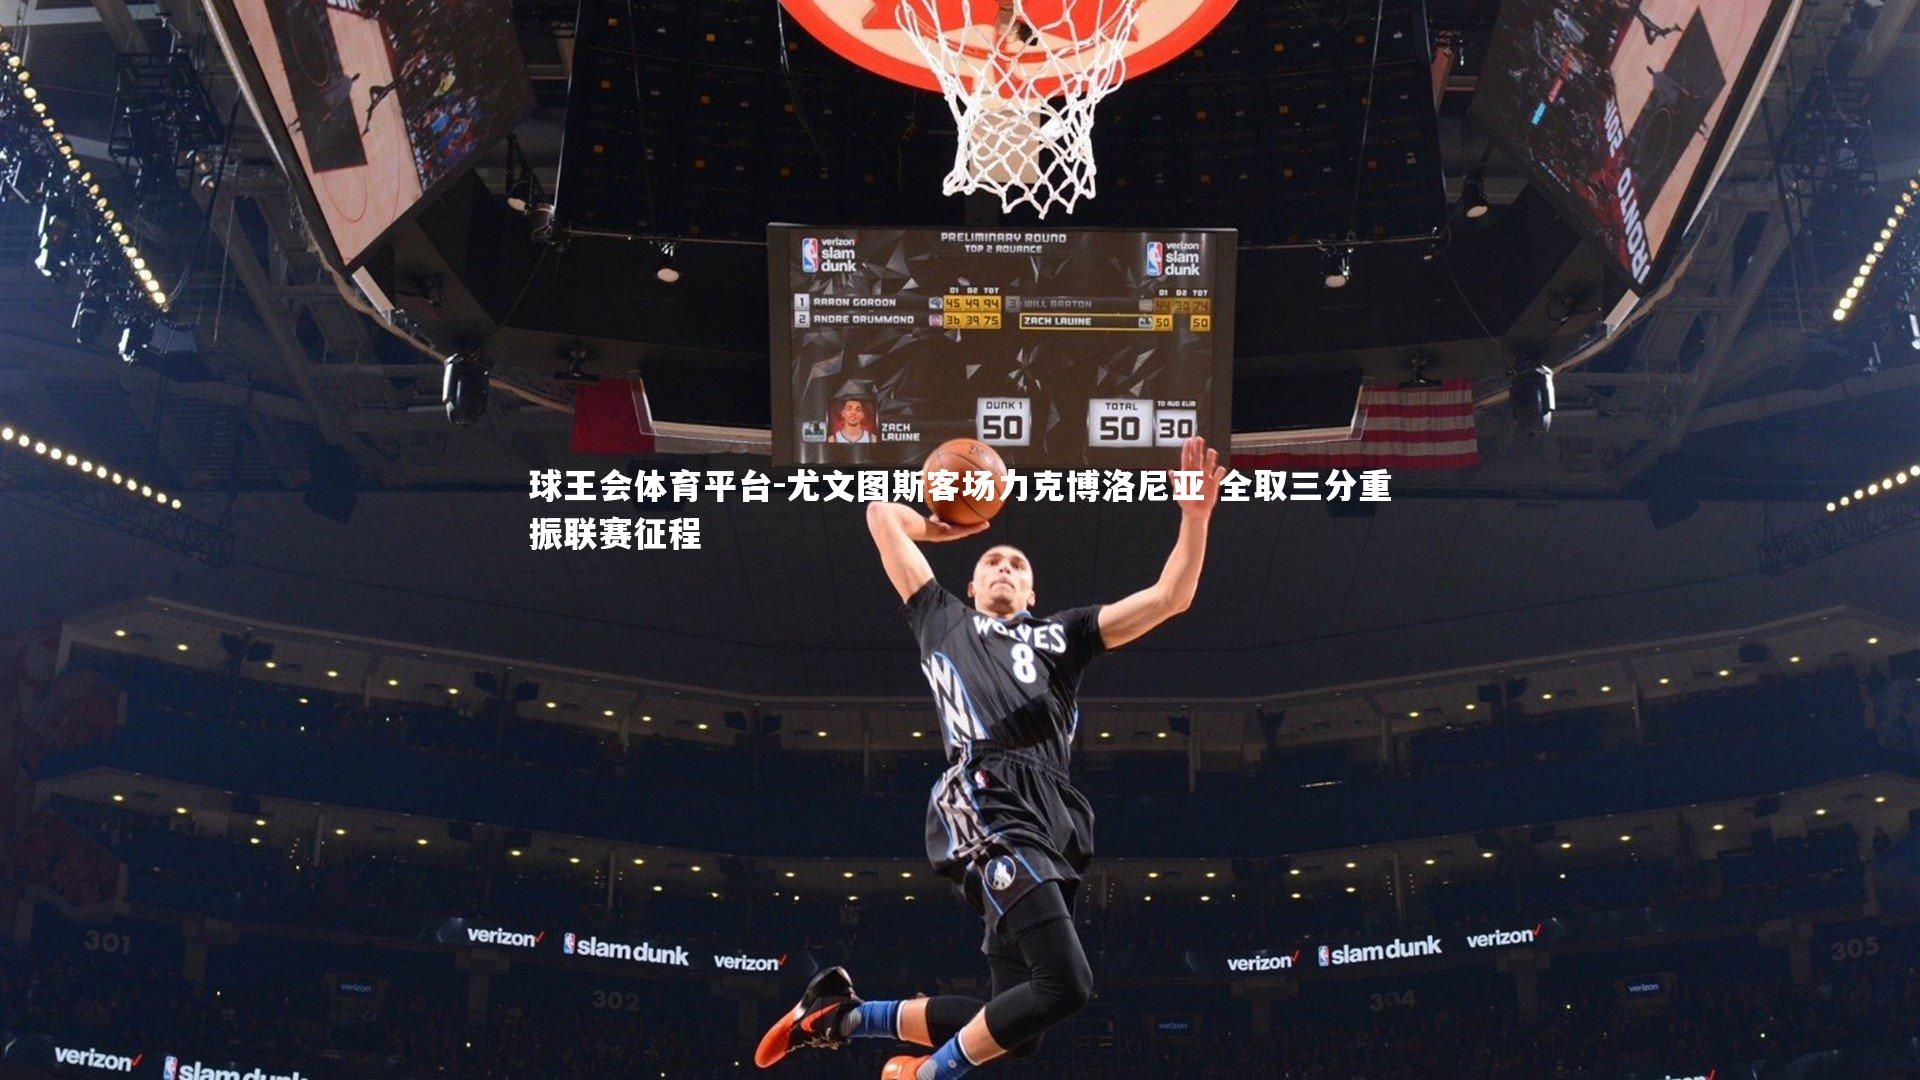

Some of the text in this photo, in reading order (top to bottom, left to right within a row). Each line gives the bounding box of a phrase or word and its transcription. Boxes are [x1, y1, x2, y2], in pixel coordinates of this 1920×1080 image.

[821, 237, 855, 246] verizon
[940, 232, 1067, 243] PRELIMINARY ROUND
[965, 244, 1043, 254] TOP 2 ADVANCE
[1165, 241, 1200, 250] verizon
[821, 246, 856, 259] slam
[1165, 250, 1200, 263] slam
[821, 259, 857, 272] dunk
[1164, 263, 1201, 276] dunk
[983, 286, 1000, 294] TOT
[813, 298, 850, 307] AARON
[852, 298, 897, 307] GORDON
[946, 298, 960, 308] 45
[965, 298, 980, 308] 49
[983, 298, 999, 308] 94
[799, 315, 806, 324] 2
[813, 315, 850, 324] ANDRE
[852, 315, 915, 325] DRUMMOND
[965, 315, 980, 325] 39
[983, 315, 999, 326] 75
[1024, 316, 1208, 327] ZACH LAVINE 50 50
[986, 401, 1015, 410] DUNK
[1106, 402, 1138, 411] TOTAL
[881, 423, 911, 431] ZACH
[983, 414, 1023, 440] 50
[1100, 416, 1140, 441] 50
[1159, 418, 1193, 438] 30
[881, 432, 920, 442] LAVINE
[973, 615, 1067, 654] WOLVES
[1011, 643, 1037, 684] 8
[467, 927, 536, 948] verizon
[1466, 929, 1534, 948] verizon
[577, 936, 689, 966] slam dunk
[1331, 935, 1442, 965] slam dunk
[714, 954, 779, 971] verizon
[1227, 953, 1293, 972] verizon
[340, 982, 372, 994] verizon
[1628, 982, 1660, 993] verizon
[54, 1046, 132, 1072] verizon
